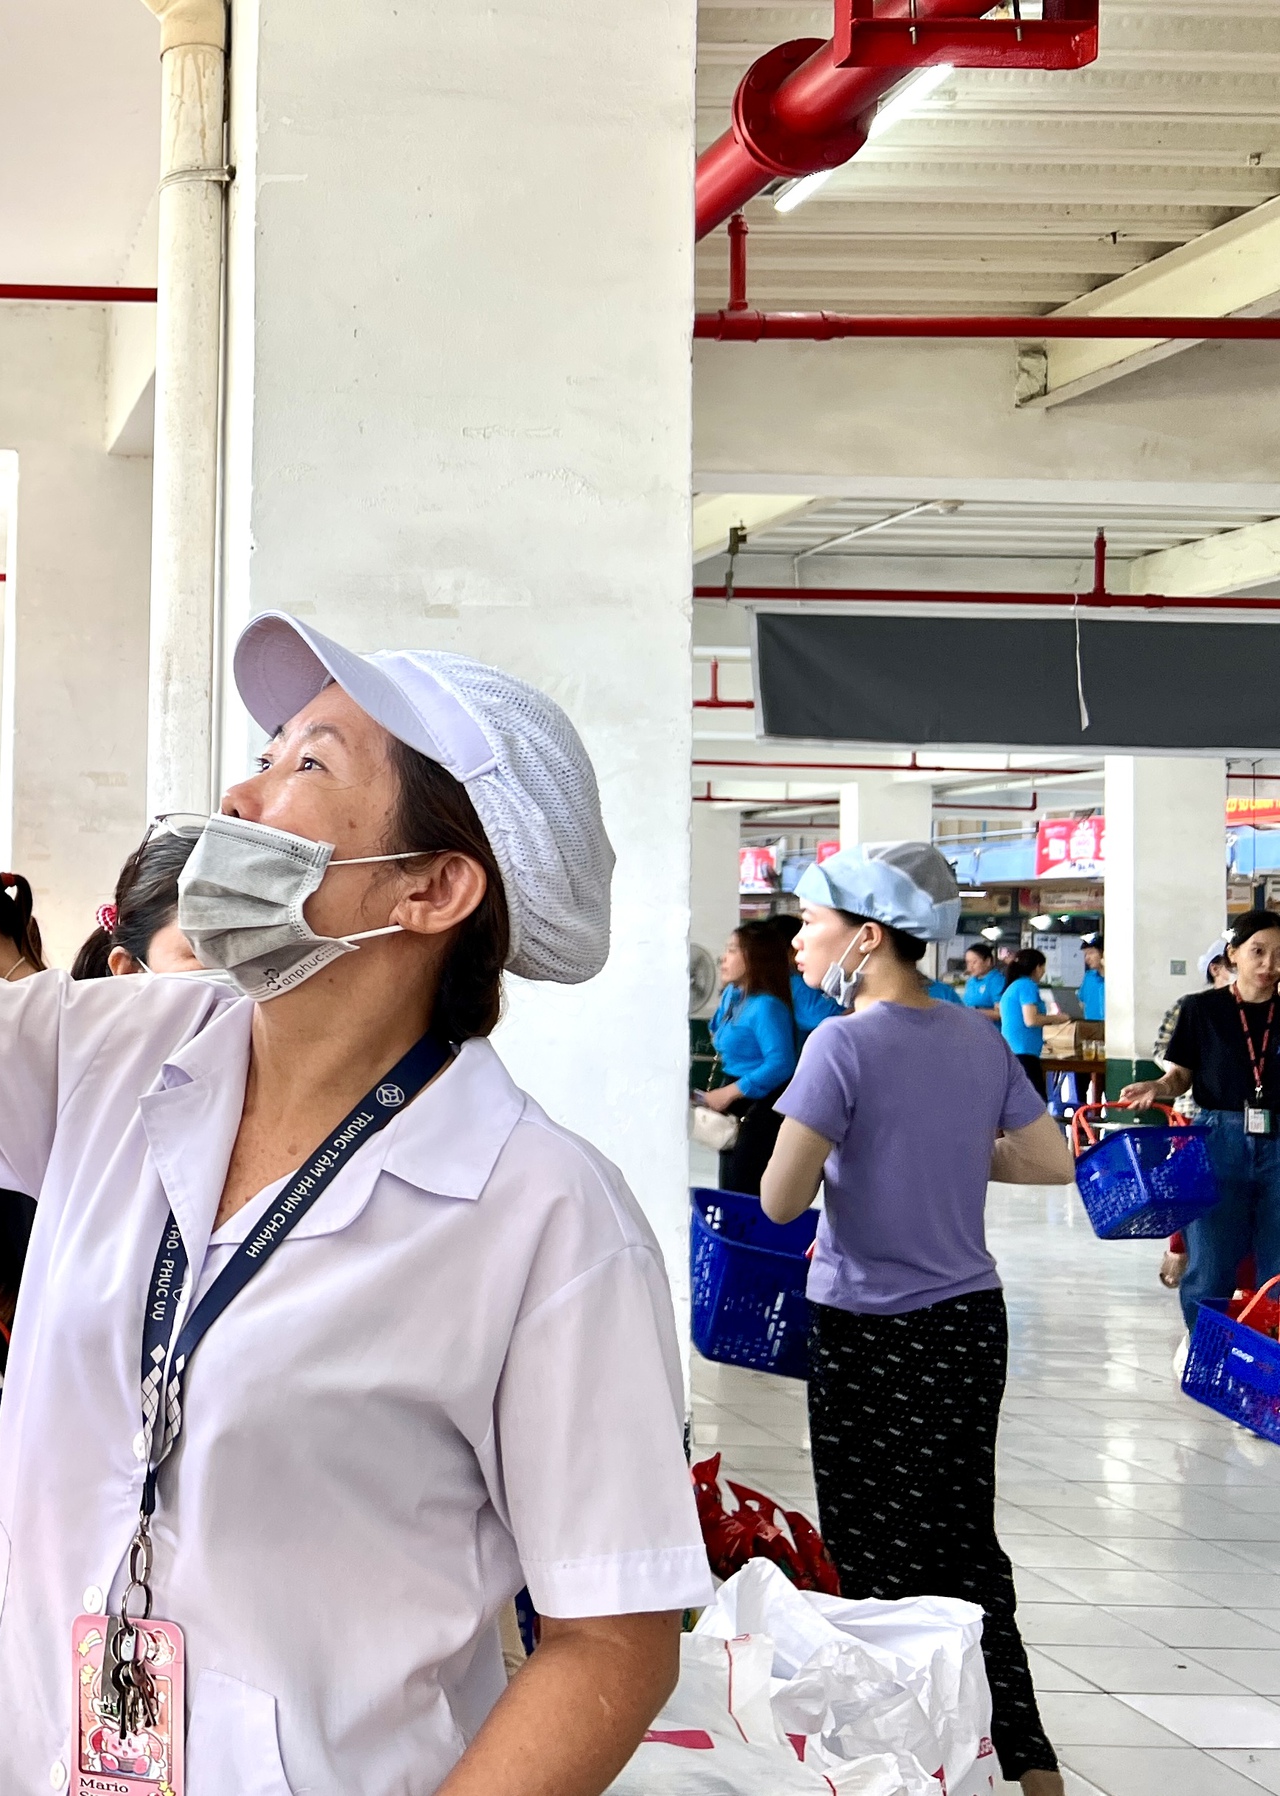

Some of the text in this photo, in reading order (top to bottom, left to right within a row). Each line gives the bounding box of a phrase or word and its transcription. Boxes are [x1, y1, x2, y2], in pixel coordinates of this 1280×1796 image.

[245, 1110, 374, 1259] TRUNG TÂM HÀNH CHÁNH
[155, 1259, 175, 1298] PHỤC
[150, 1300, 166, 1321] VỤ
[79, 1777, 129, 1794] Mario
